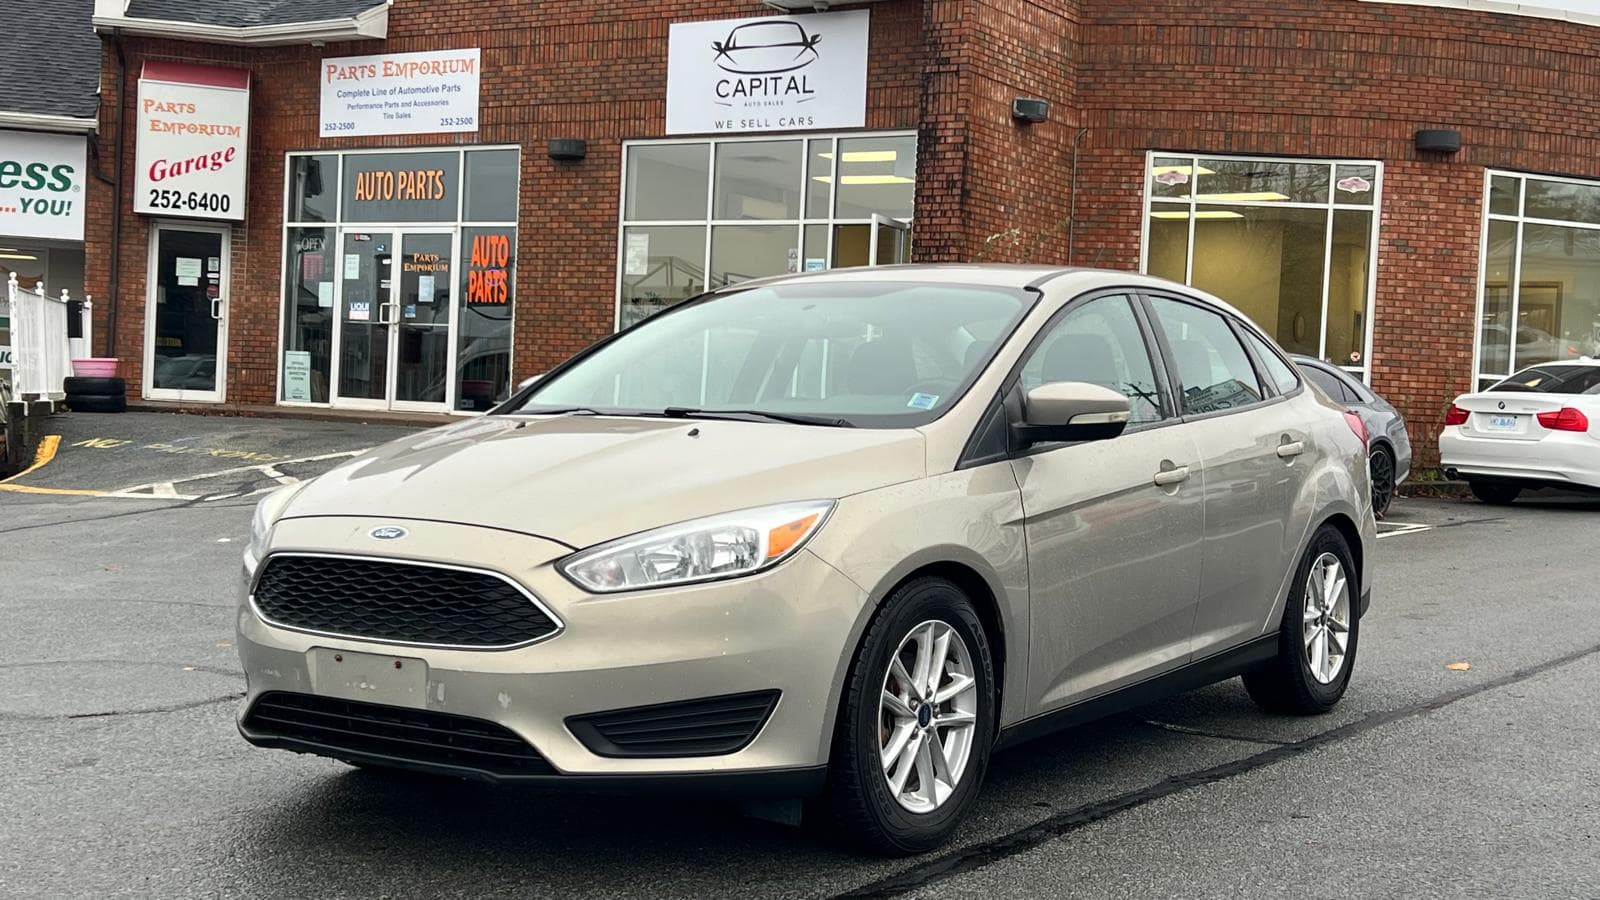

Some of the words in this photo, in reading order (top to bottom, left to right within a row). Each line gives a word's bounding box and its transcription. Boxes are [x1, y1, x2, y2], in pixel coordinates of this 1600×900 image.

[336, 89, 371, 99] Complete
[371, 88, 388, 97] Line
[388, 87, 398, 96] of
[398, 86, 440, 95] Automotive
[441, 84, 462, 93] Parts
[715, 75, 815, 98] CAPITAL
[347, 102, 384, 110] Performance
[384, 101, 400, 109] Parts
[400, 100, 412, 108] and
[412, 99, 449, 107] Accessories
[383, 112, 395, 120] Tire
[440, 117, 474, 126] 252-2500
[715, 120, 733, 128] WE
[741, 119, 771, 128] SELL
[778, 116, 814, 126] CARS
[324, 122, 356, 131] 252-2500
[148, 146, 236, 182] Garage
[355, 171, 394, 201] AUTO
[397, 169, 445, 200] PARTS
[149, 188, 230, 213] 252-6400
[470, 235, 510, 268] AUTO
[468, 270, 508, 304] PARTS
